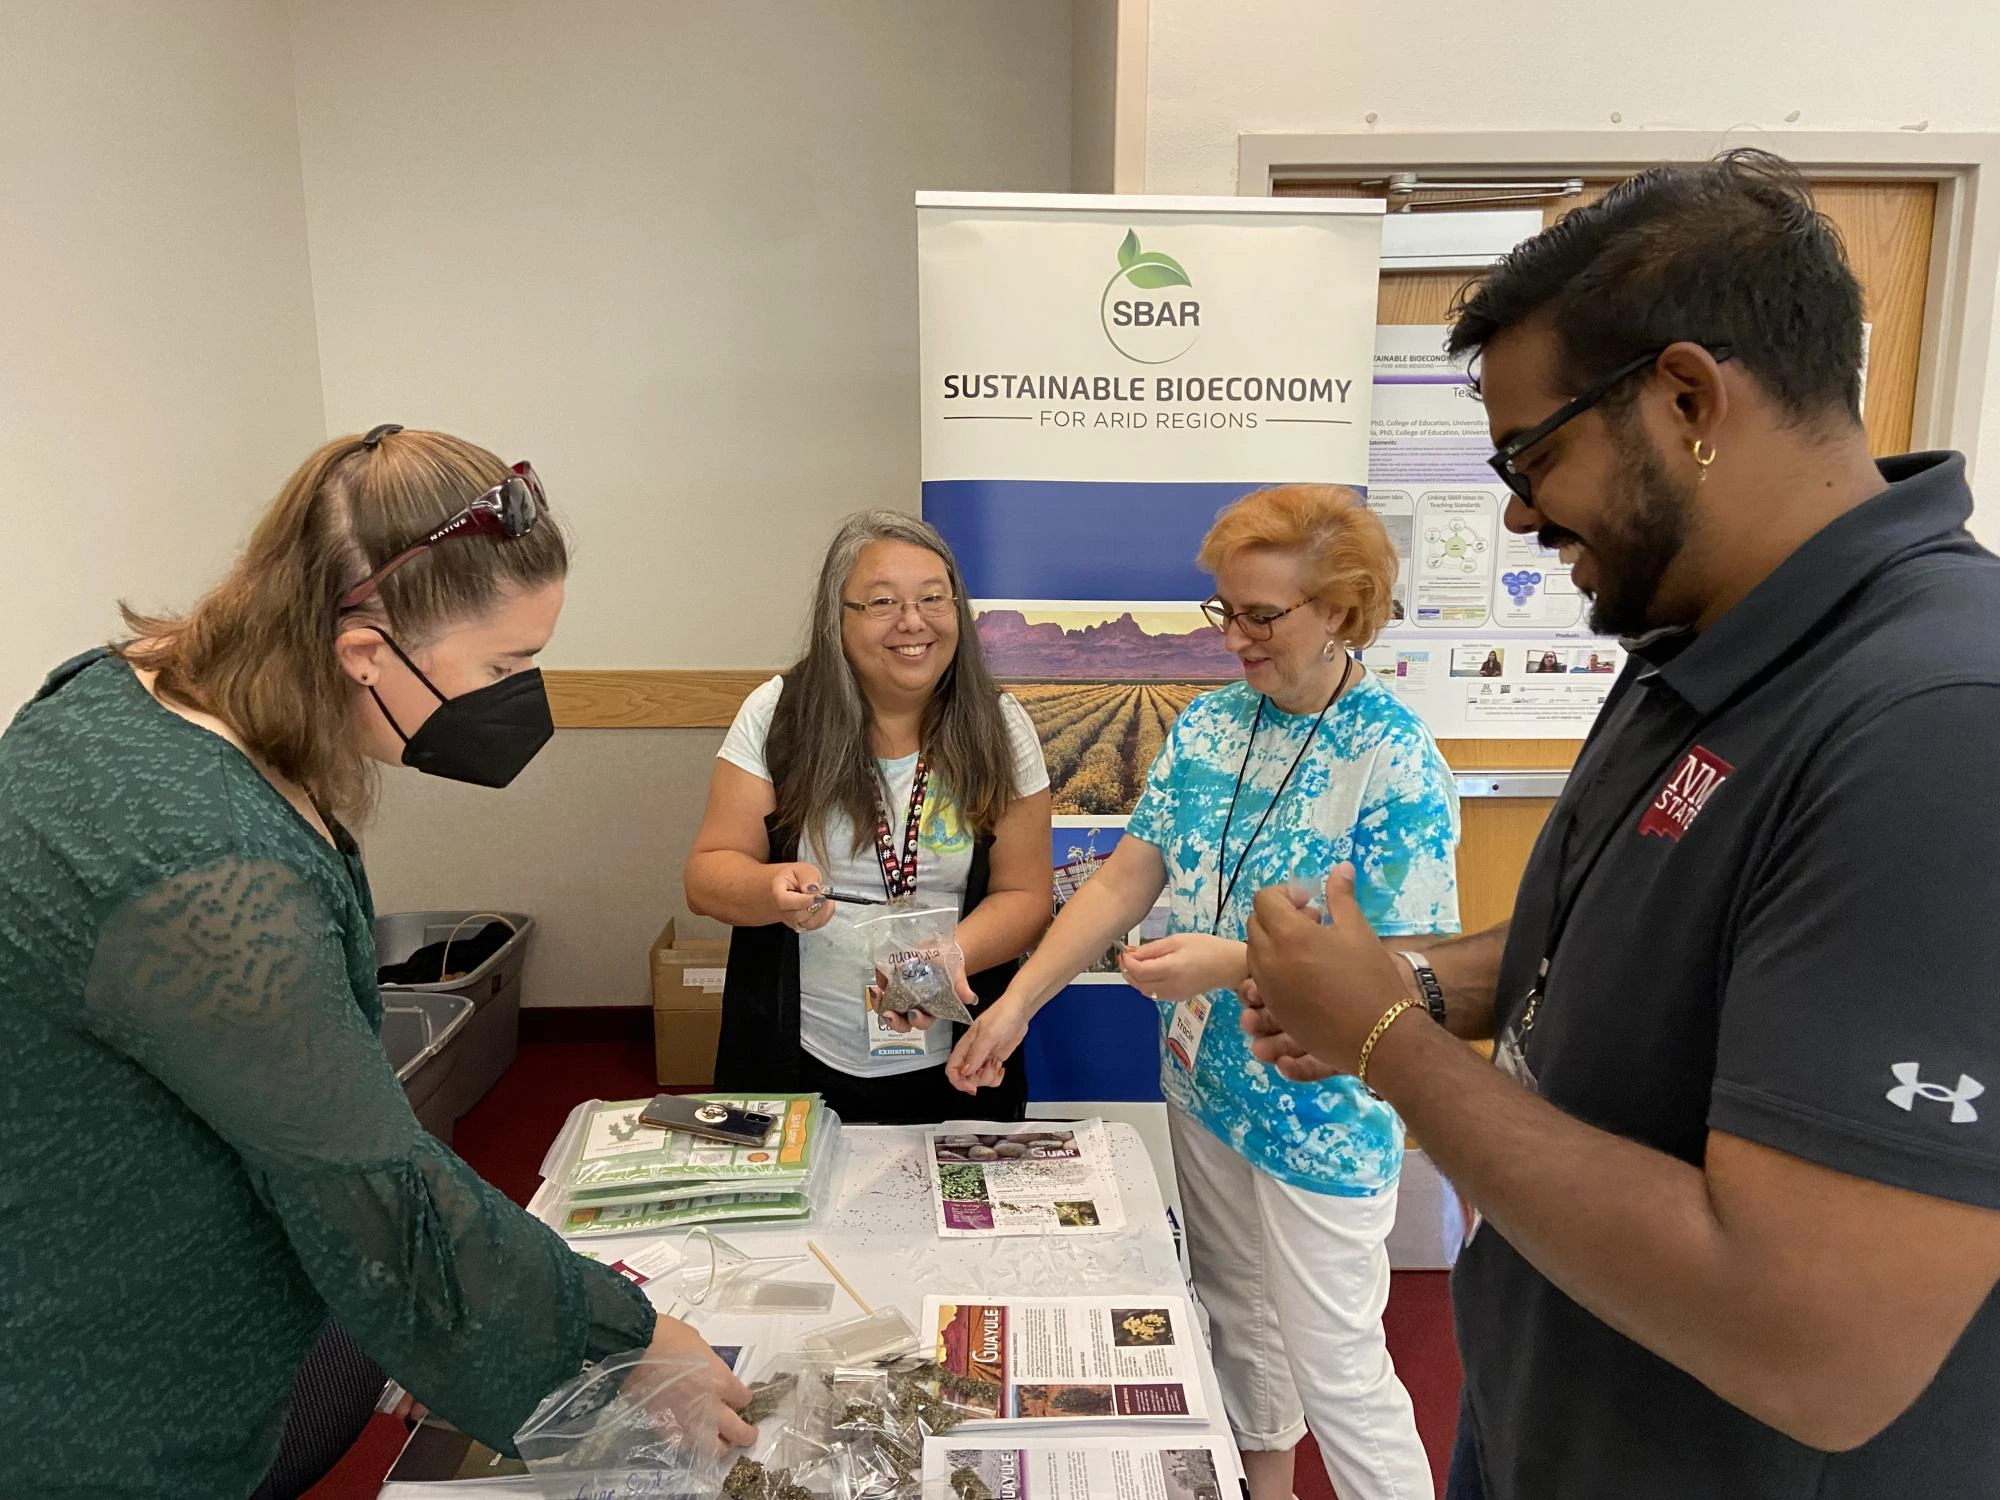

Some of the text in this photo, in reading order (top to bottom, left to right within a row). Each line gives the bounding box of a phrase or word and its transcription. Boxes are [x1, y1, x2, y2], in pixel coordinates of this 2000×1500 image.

[1113, 300, 1200, 327] SBAR
[944, 374, 1353, 404] SUSTAINABLE BIOECONOMY
[1040, 410, 1258, 429] FOR ARID REGIONS
[1386, 420, 1410, 428] College
[1453, 420, 1484, 428] University
[429, 517, 467, 541] NATIVE
[878, 1048, 916, 1056] EXHIBITOR
[1031, 1146, 1076, 1158] GUAR
[971, 1309, 999, 1363] GUAYULE
[1001, 1454, 1016, 1499] UAYULE
